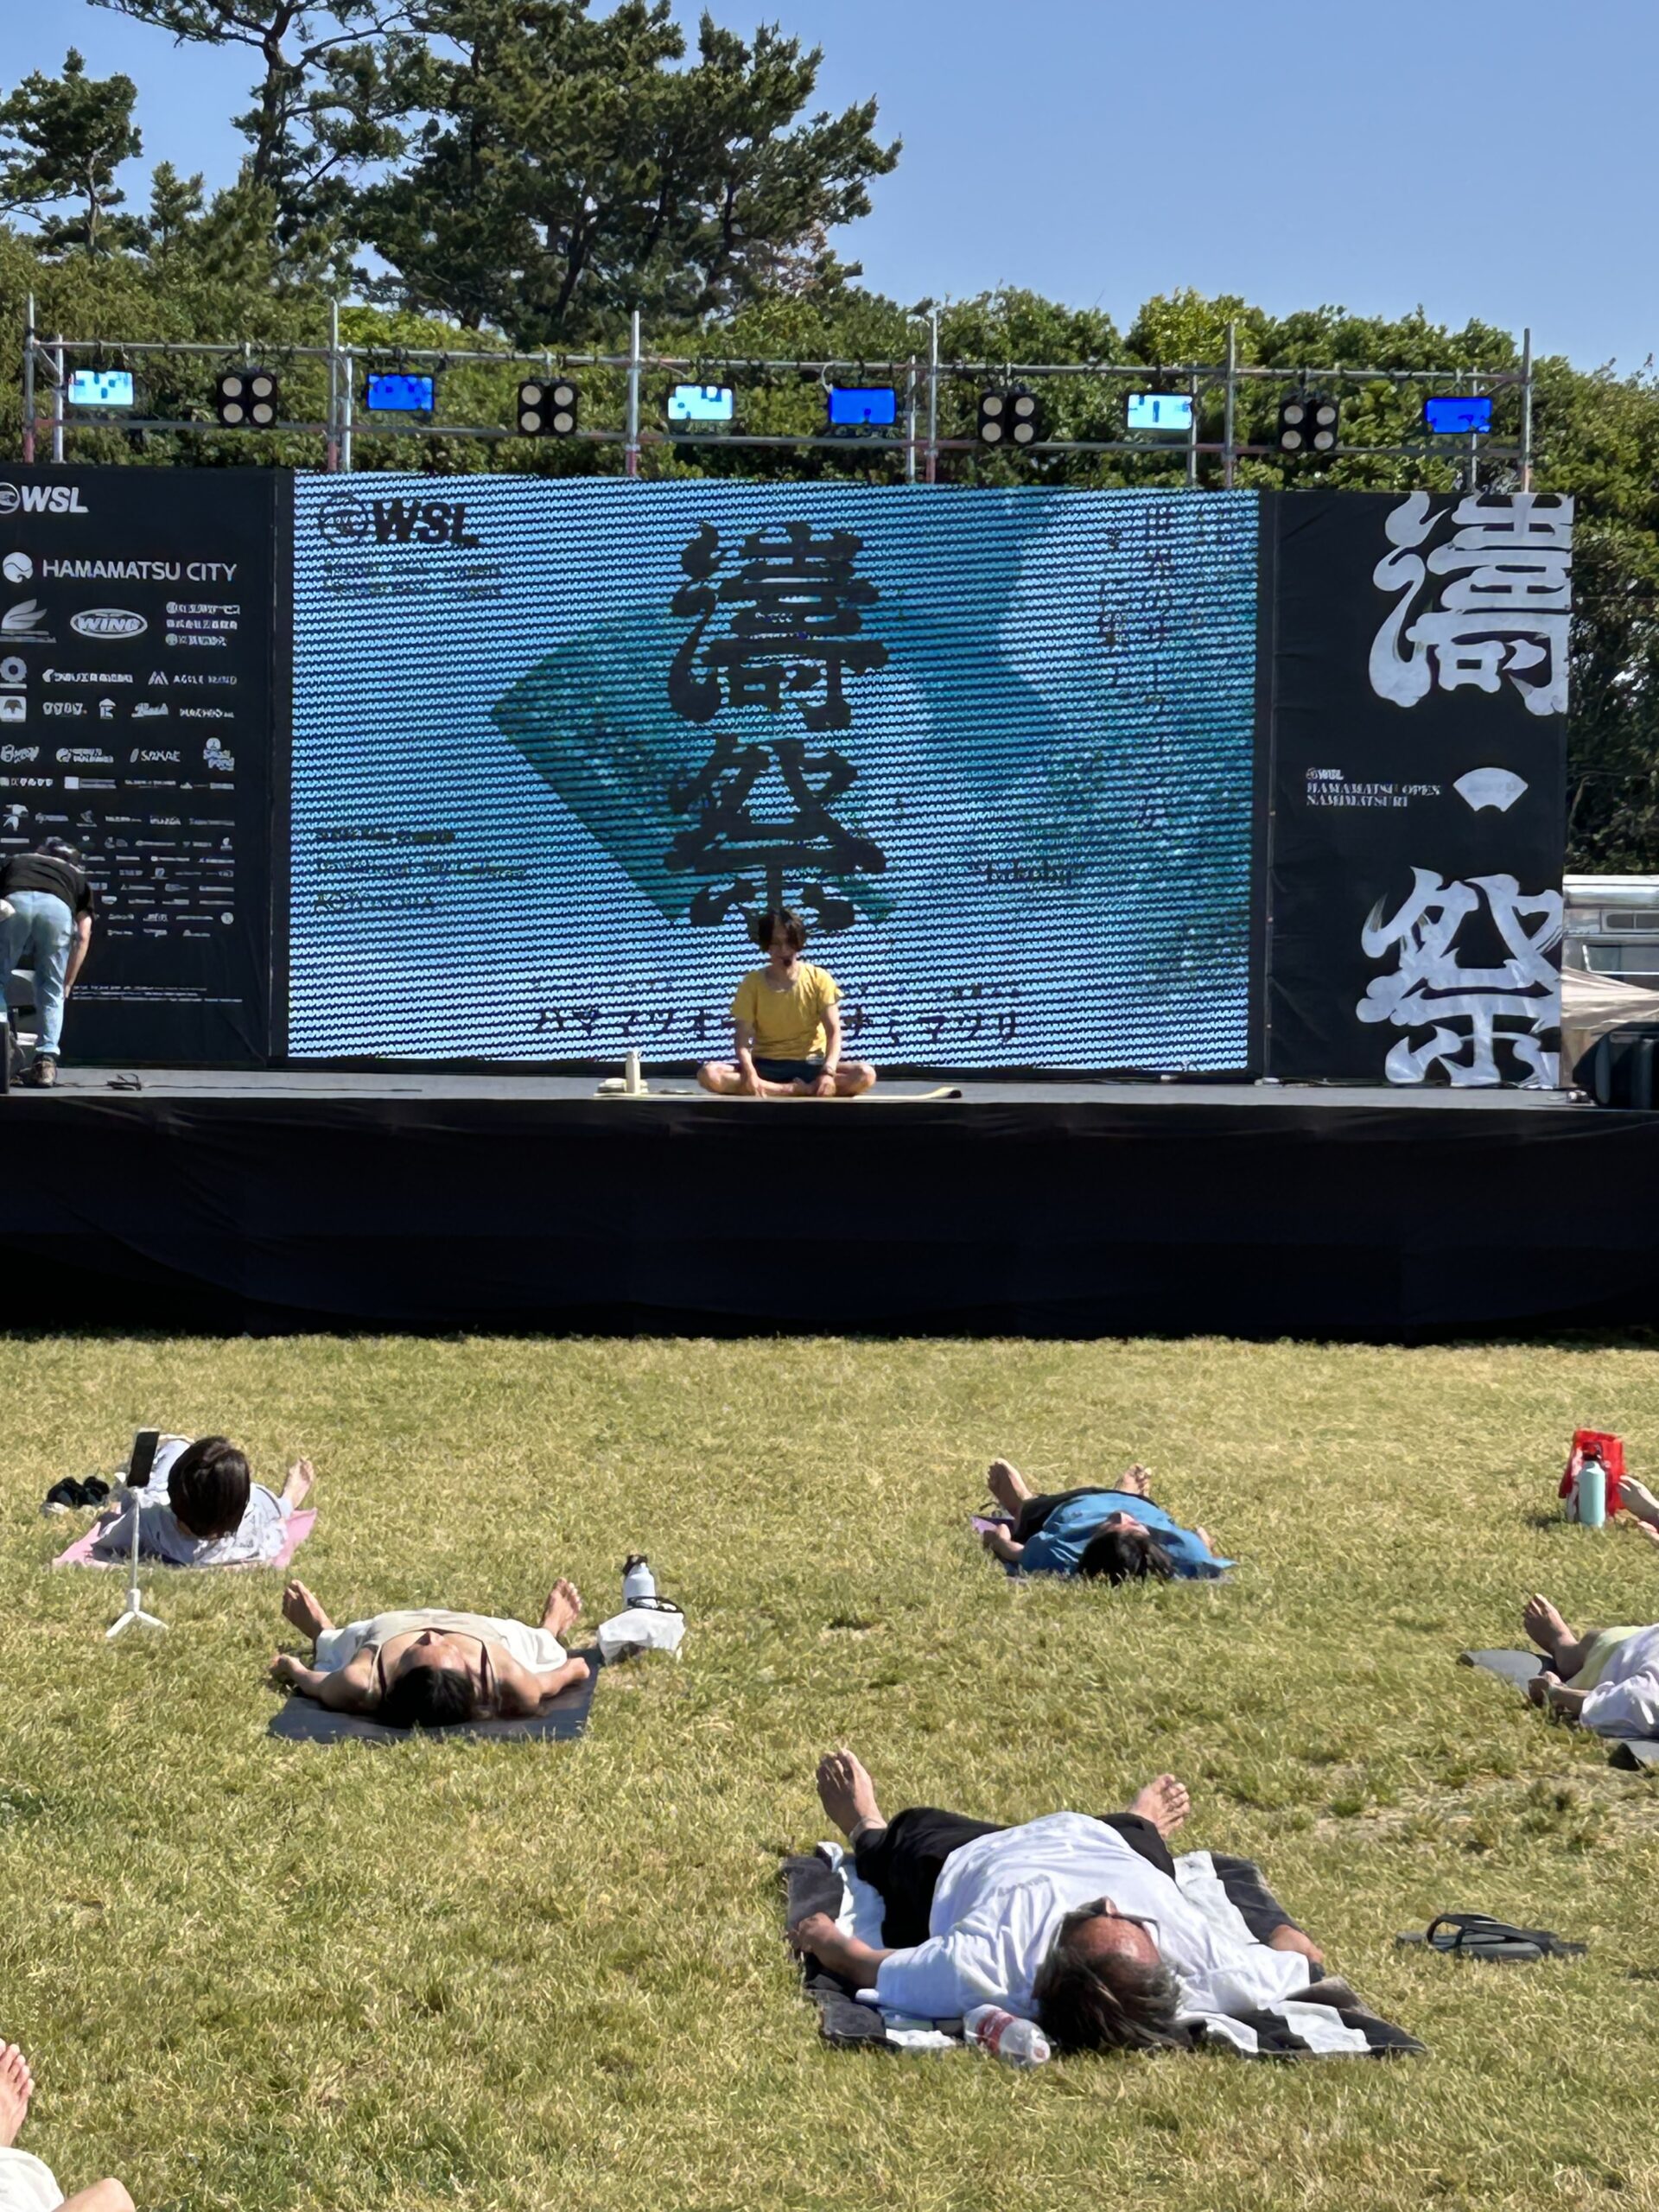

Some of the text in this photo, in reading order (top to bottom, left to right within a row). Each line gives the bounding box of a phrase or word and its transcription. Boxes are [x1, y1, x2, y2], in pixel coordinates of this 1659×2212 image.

[22, 486, 89, 512] WSL
[372, 498, 480, 548] WSL
[43, 559, 238, 582] HAMAMATSU CITY
[77, 617, 140, 632] WING
